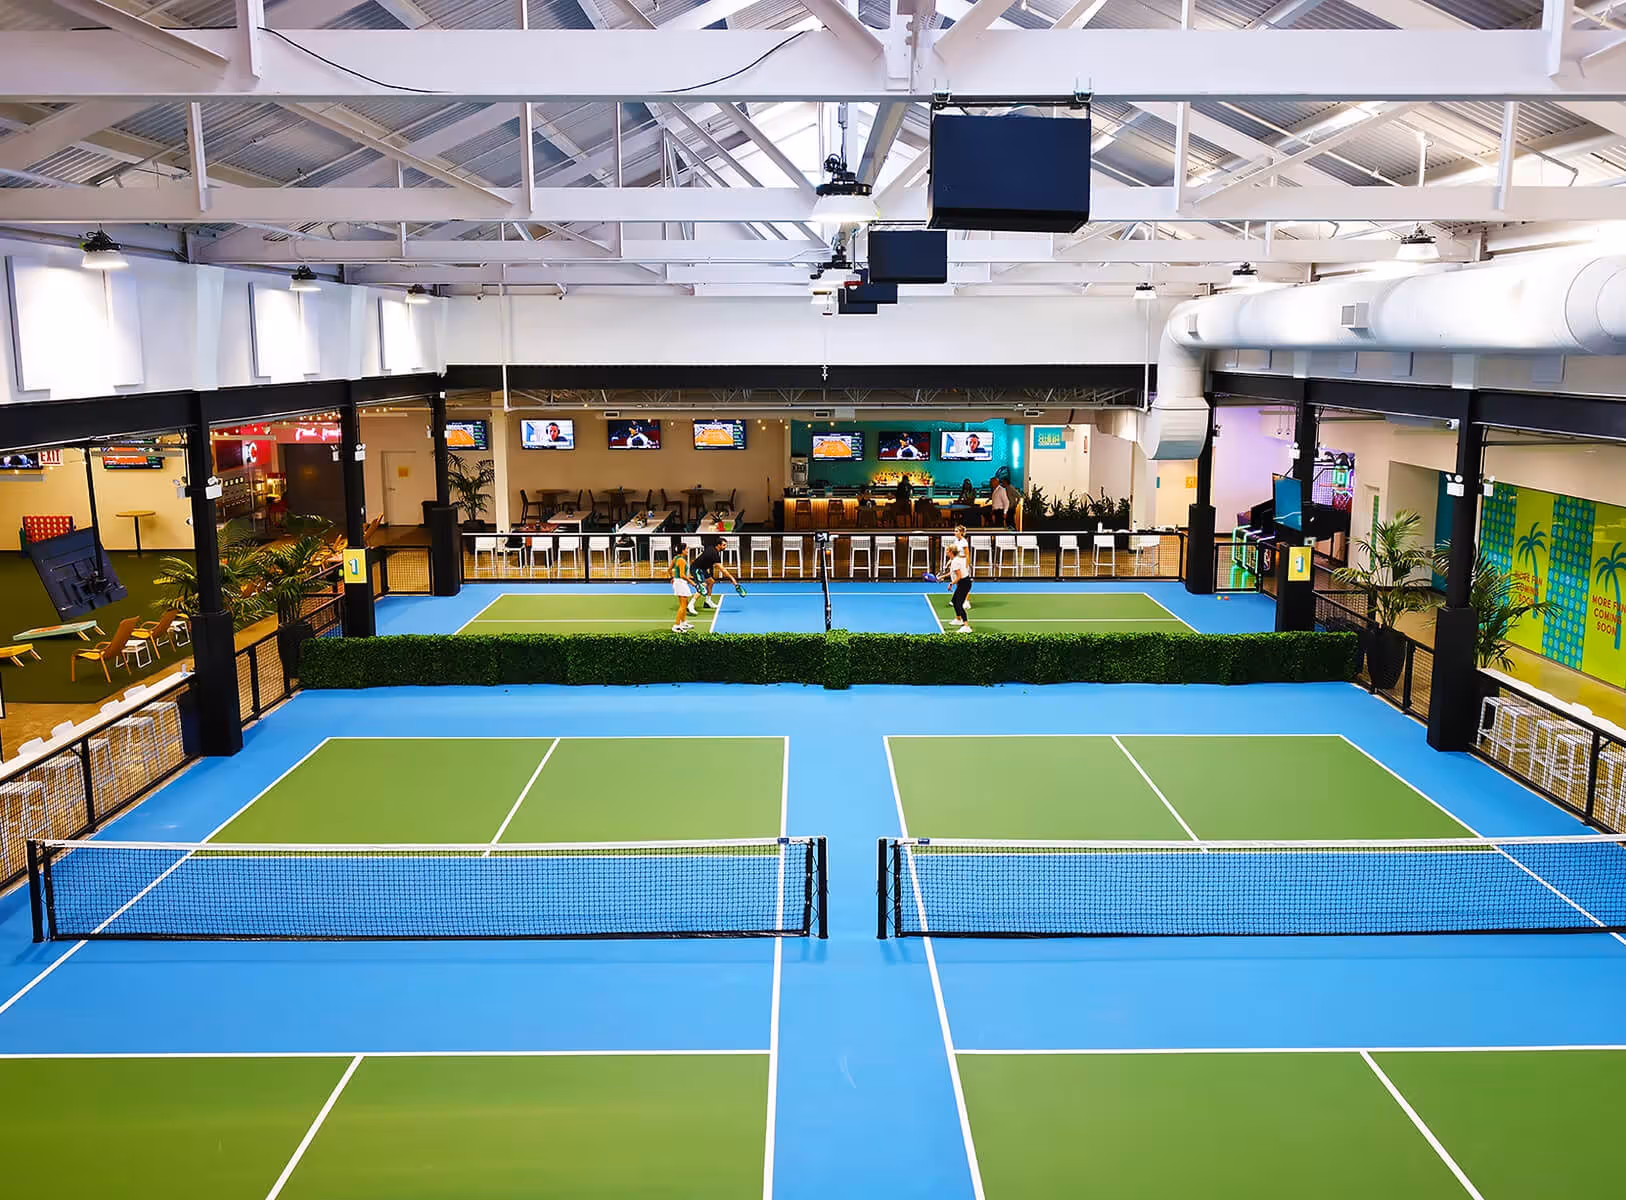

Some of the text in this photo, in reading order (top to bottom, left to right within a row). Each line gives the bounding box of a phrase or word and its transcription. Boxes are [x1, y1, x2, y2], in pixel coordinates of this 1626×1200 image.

[40, 448, 60, 462] EXIT
[348, 558, 359, 575] 1
[1296, 556, 1304, 573] 1
[1592, 594, 1626, 614] MORE FUN
[1593, 607, 1622, 625] COMING
[1596, 621, 1617, 636] SOON
